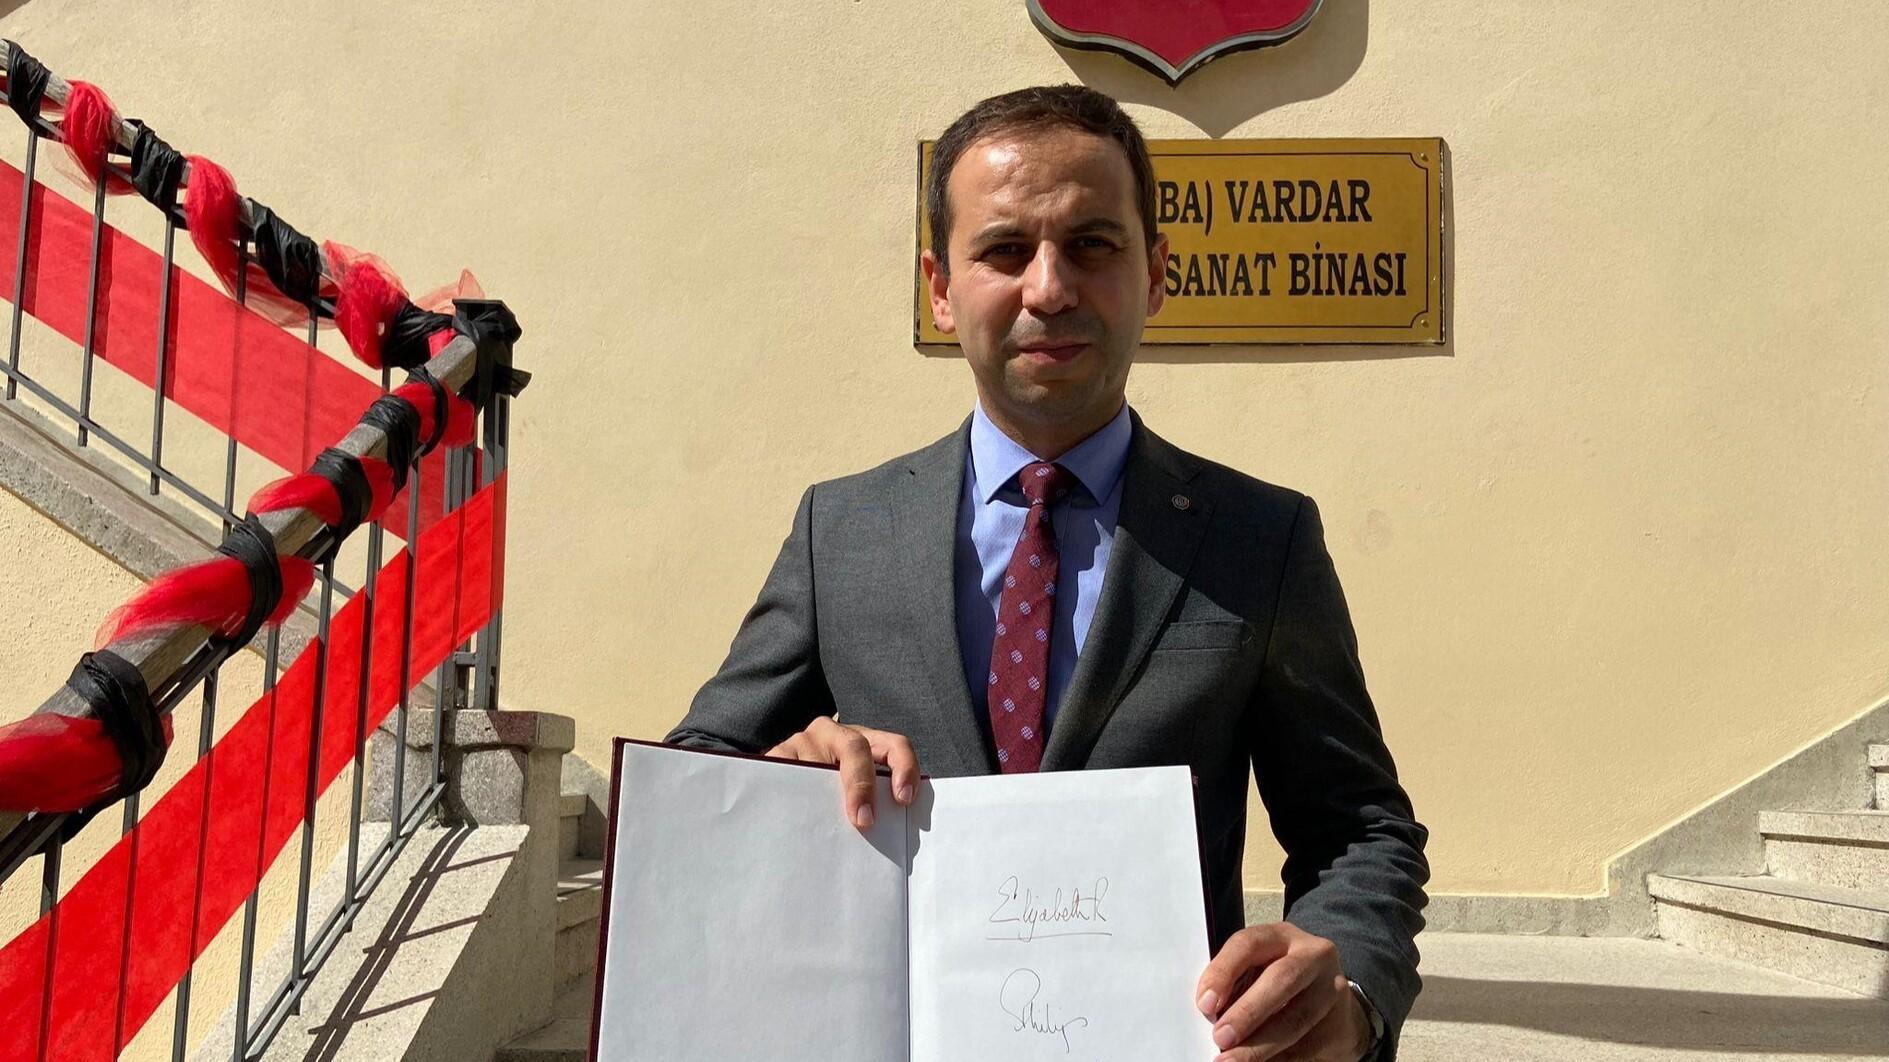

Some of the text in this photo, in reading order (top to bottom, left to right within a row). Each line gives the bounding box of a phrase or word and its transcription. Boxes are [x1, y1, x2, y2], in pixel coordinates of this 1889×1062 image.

[1225, 180, 1372, 223] VARDAR
[1166, 242, 1407, 297] SANAT BİNASI
